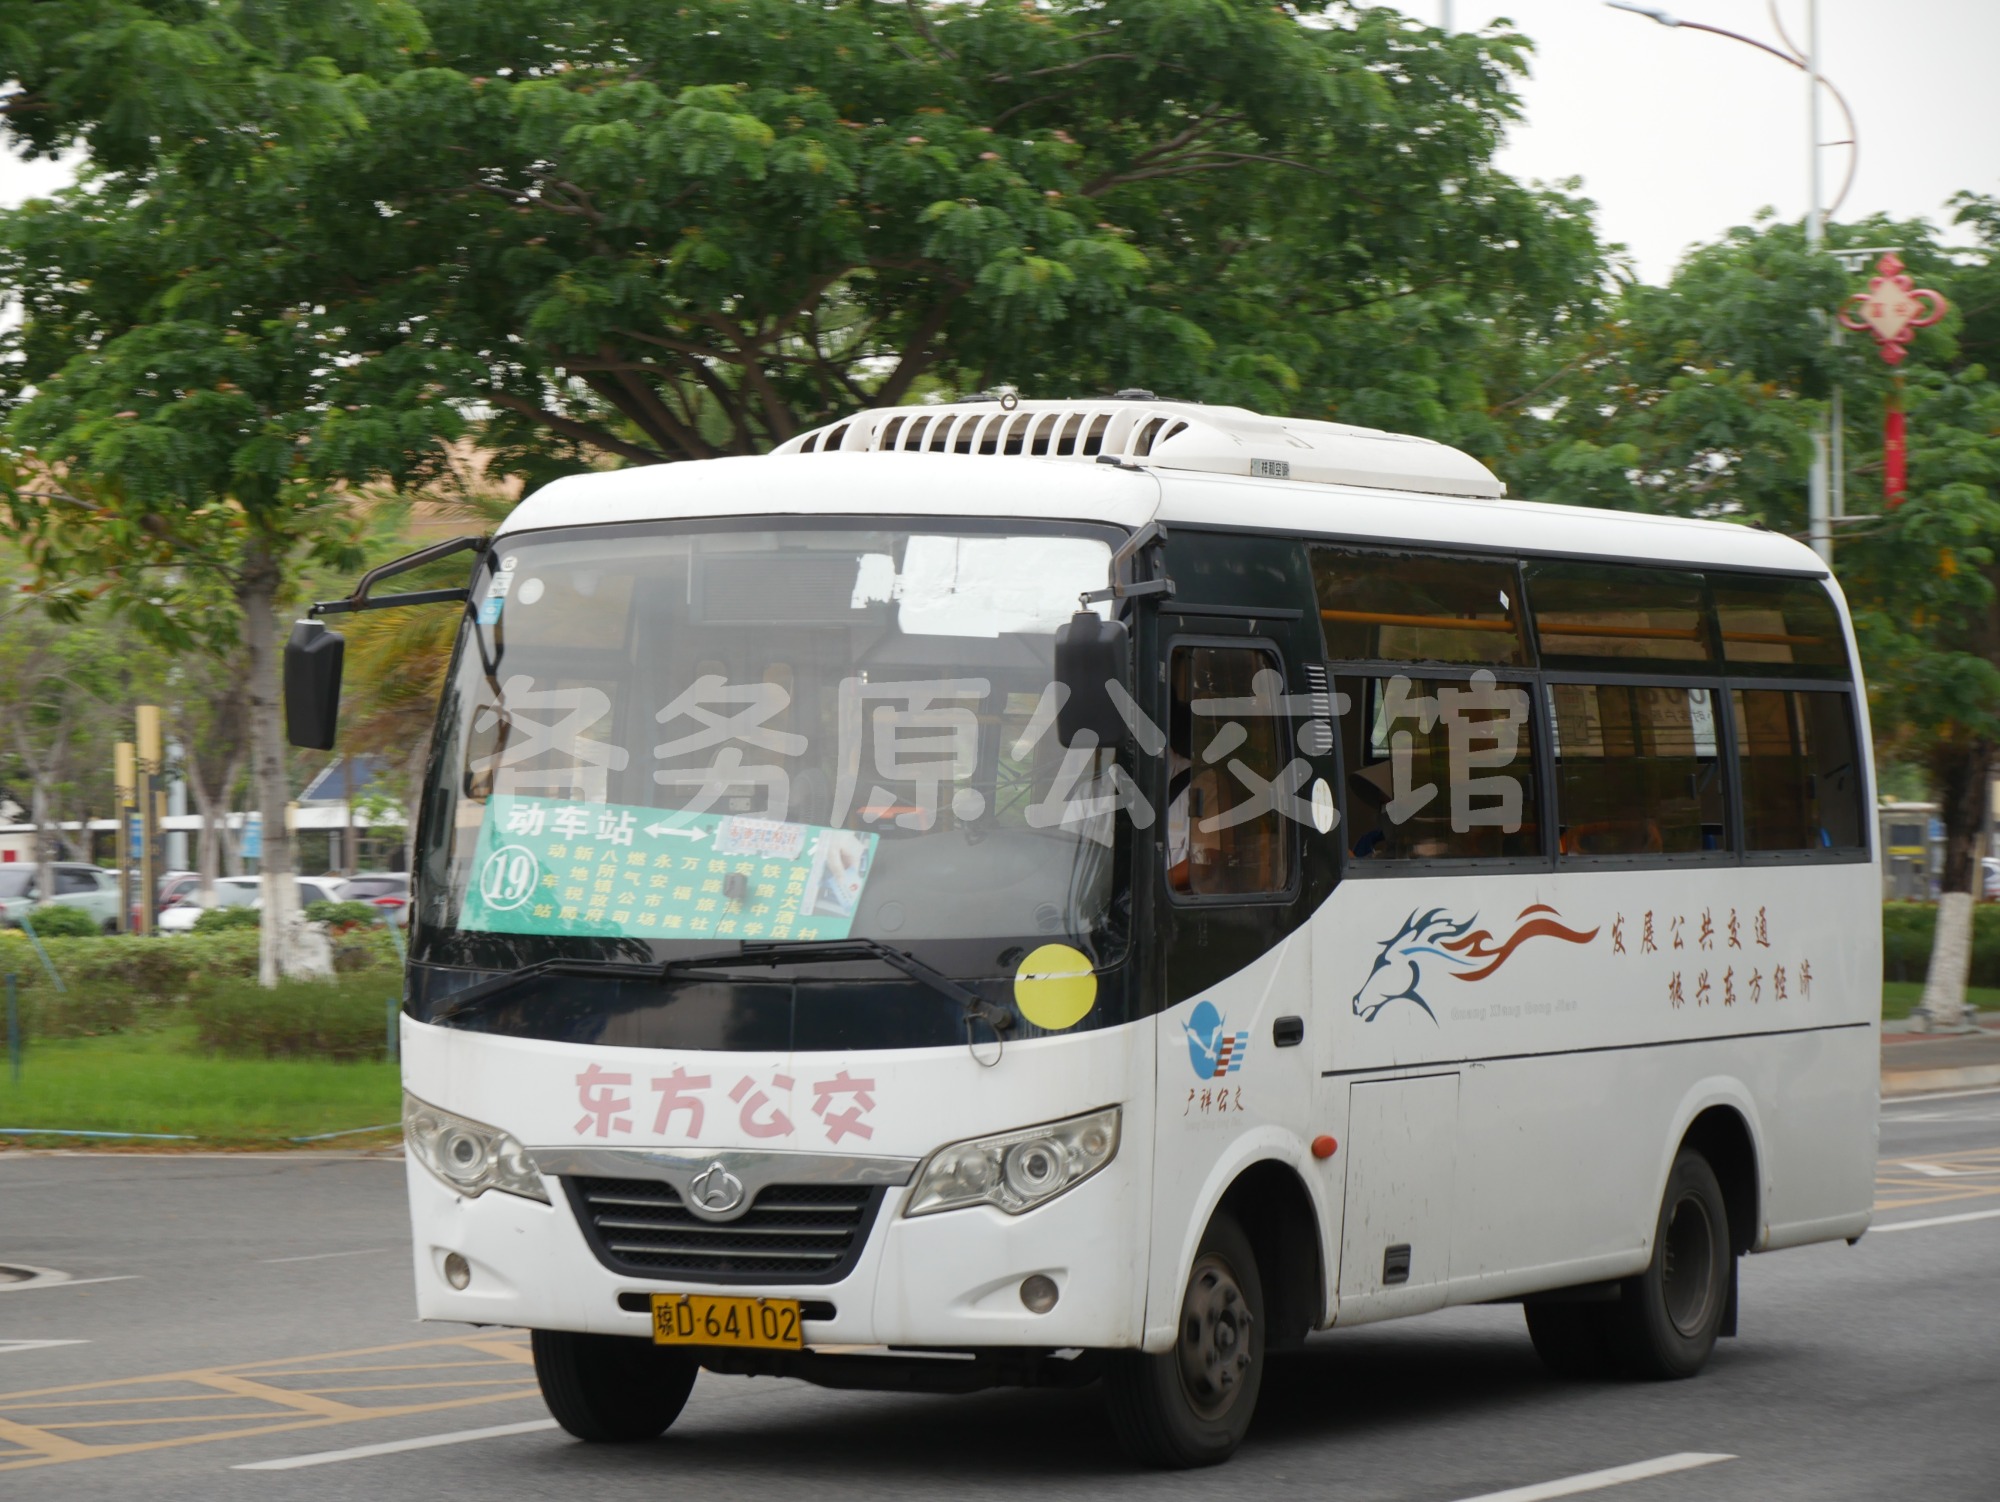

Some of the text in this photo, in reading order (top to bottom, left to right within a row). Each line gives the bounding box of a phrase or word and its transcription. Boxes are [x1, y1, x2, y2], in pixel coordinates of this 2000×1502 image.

[507, 802, 637, 847] 动车站
[486, 854, 530, 900] 19
[1611, 905, 1771, 955] 发展公共交通
[1668, 958, 1814, 1010] 振兴东方经济
[573, 1063, 877, 1145] 东方公交
